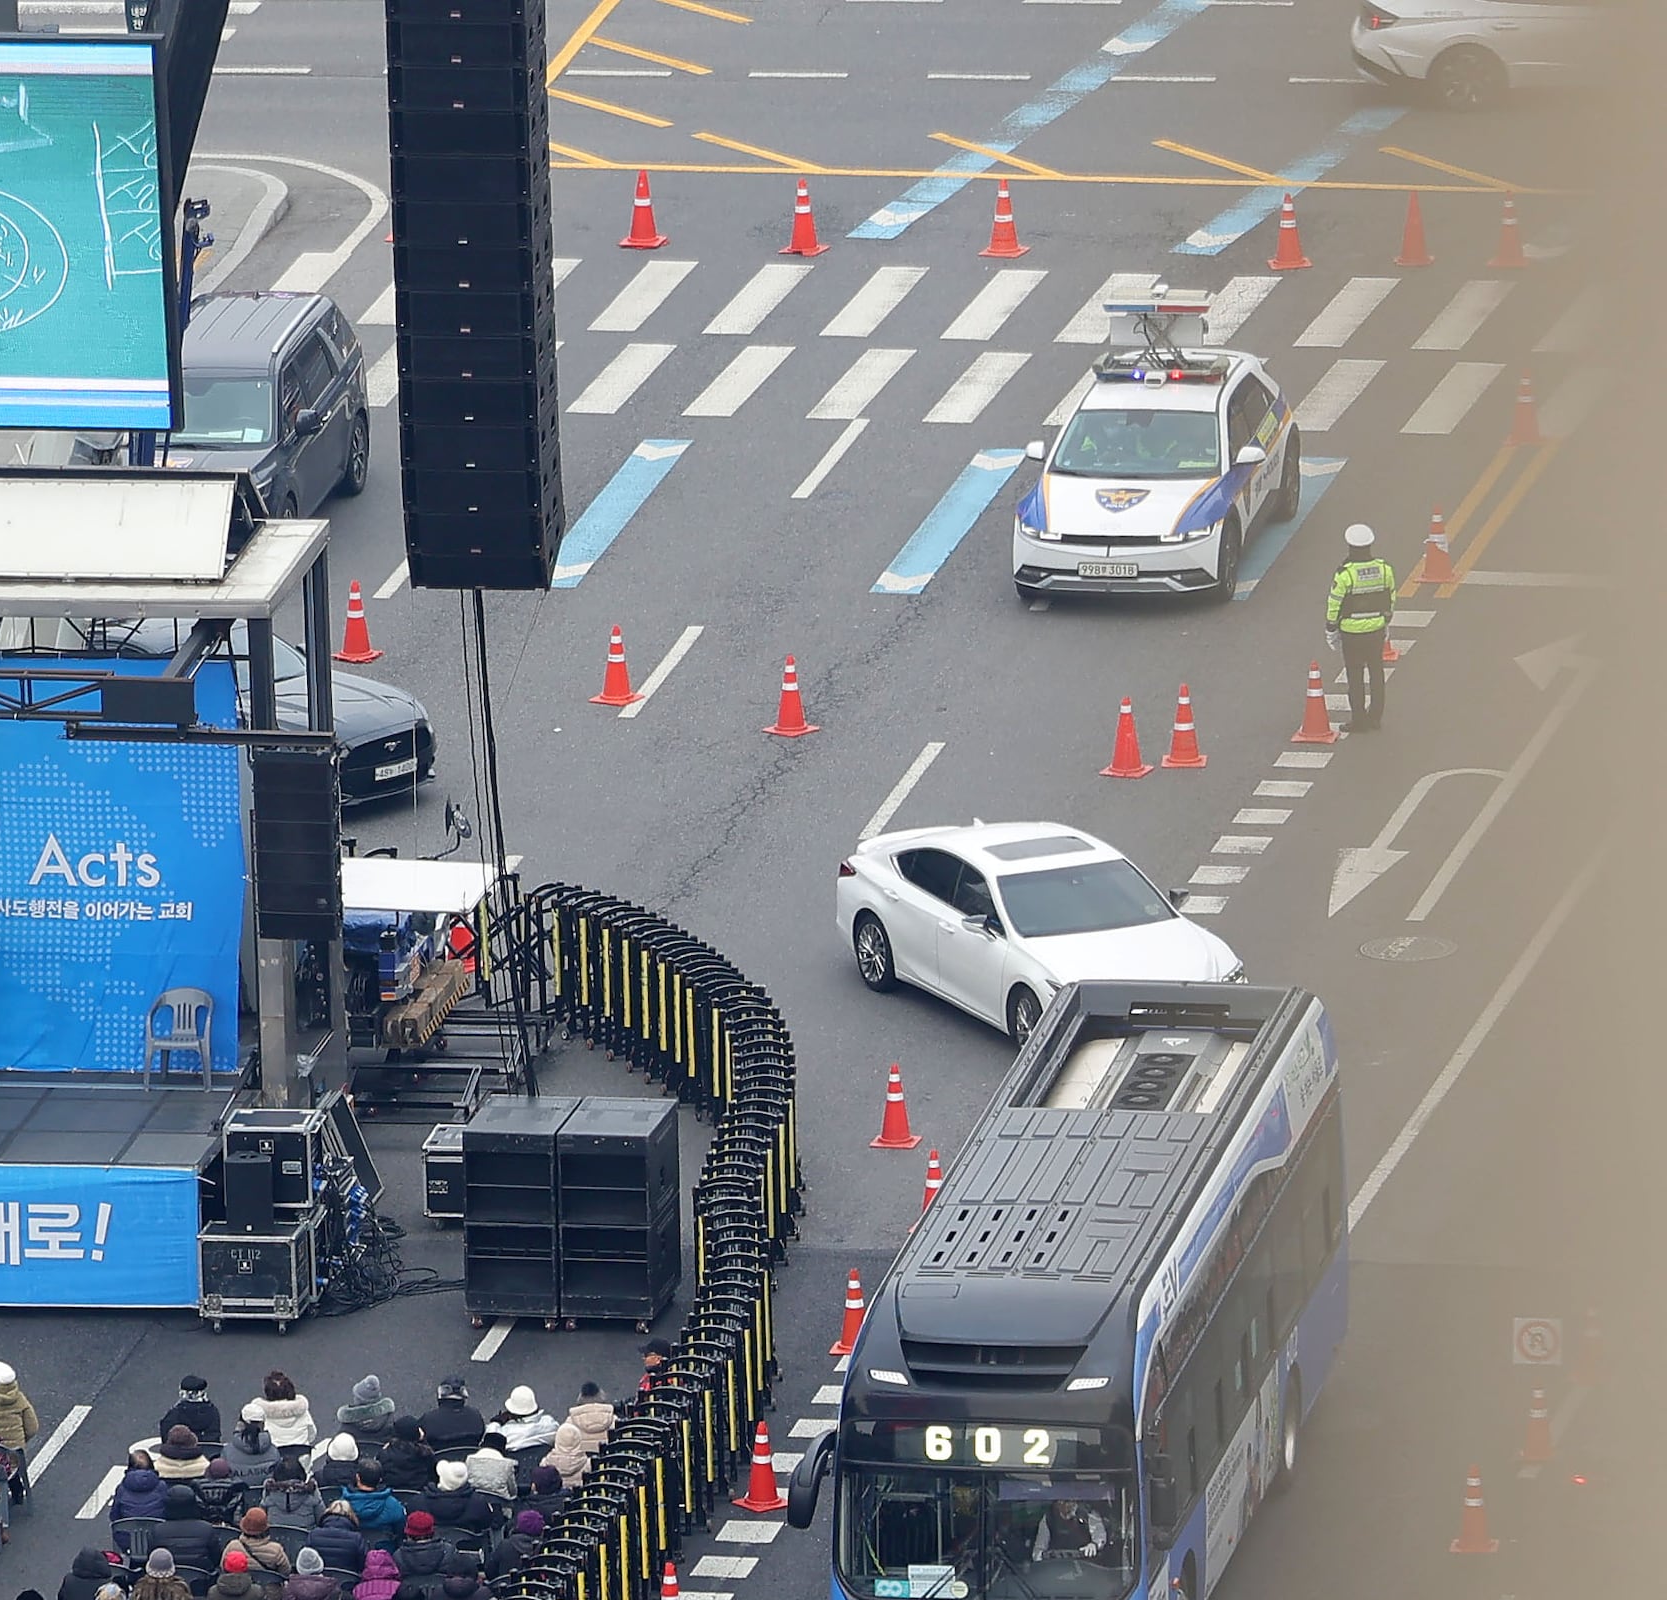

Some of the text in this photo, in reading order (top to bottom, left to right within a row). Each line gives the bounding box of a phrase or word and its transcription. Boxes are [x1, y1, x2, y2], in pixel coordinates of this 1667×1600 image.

[1108, 565, 1135, 576] 3018
[28, 832, 161, 888] Acts
[85, 901, 154, 921] 이어가는
[158, 902, 193, 922] 교회
[230, 1249, 245, 1260] CT
[925, 1425, 1050, 1464] 602
